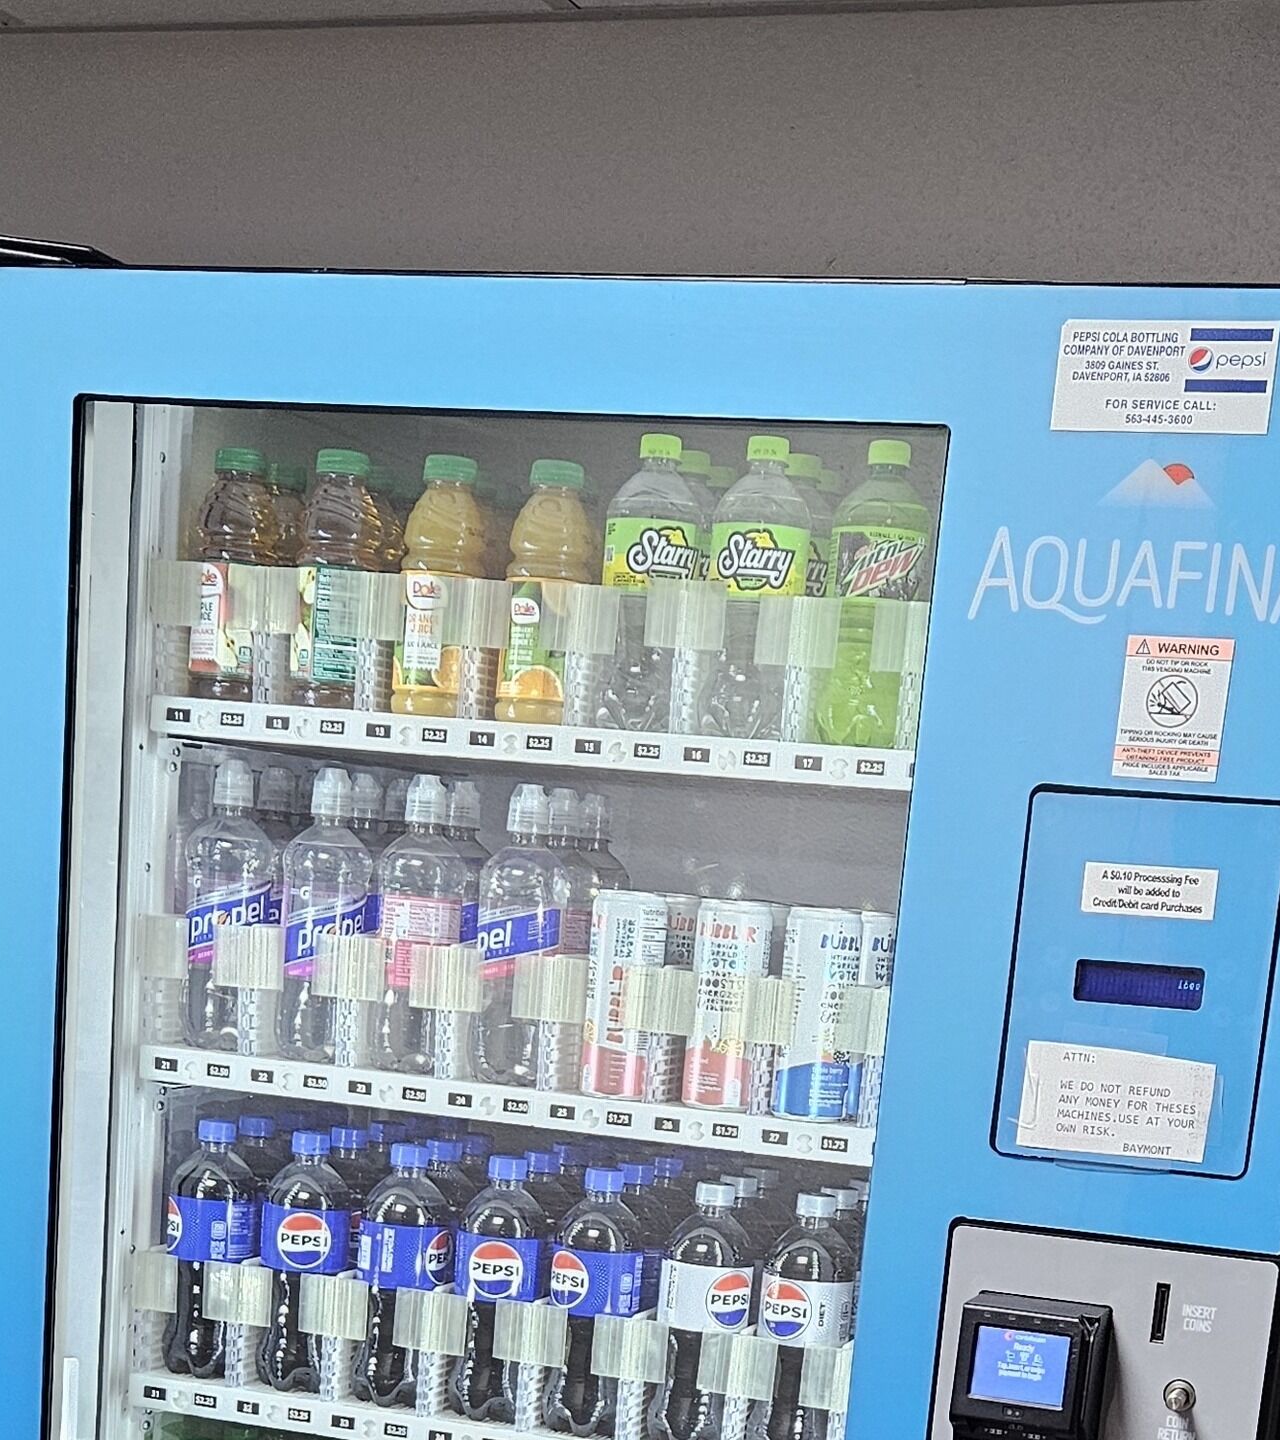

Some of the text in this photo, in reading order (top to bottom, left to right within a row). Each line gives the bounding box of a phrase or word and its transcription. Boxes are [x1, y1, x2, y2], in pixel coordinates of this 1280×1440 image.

[1073, 331, 1179, 343] PEPSI COLA BOTTLING
[1063, 345, 1186, 357] COMPANY OF DAVENPORT
[1107, 361, 1144, 371] GAINES
[1145, 362, 1160, 371] ST.
[1215, 352, 1267, 370] pepsi
[1072, 371, 1130, 383] DAVENPORT,
[1132, 373, 1143, 382] IA
[1105, 399, 1217, 411] FOR SERVICE CALL:
[1125, 414, 1193, 425] 563-445-3600
[628, 528, 698, 582] Starry
[720, 530, 796, 589] Starry
[413, 580, 442, 596] Dole
[513, 602, 537, 614] Dole
[1157, 643, 1220, 656] WARNING
[174, 710, 814, 769] 11 $2.25 17
[1102, 870, 1109, 879] A
[1110, 870, 1133, 881] $0.10
[1184, 875, 1200, 886] Fee
[1118, 885, 1181, 898] will be added to
[1140, 900, 1159, 910] card
[1160, 901, 1203, 914] Purchases
[1063, 1052, 1096, 1064] ATTN:
[160, 1060, 426, 1101] 21 $2.50
[1060, 1080, 1171, 1098] WE DO NOT REFUND
[1058, 1094, 1196, 1115] ANY MONEY FOR THESES
[1056, 1122, 1115, 1137] OWN RISK.
[1146, 1116, 1161, 1126] AT
[1167, 1117, 1196, 1130] YOUR
[1122, 1143, 1172, 1156] BAYMONT
[280, 1232, 328, 1248] PEPSI
[473, 1261, 520, 1277] PEPSI
[551, 1271, 585, 1289] PEPSI
[765, 1302, 808, 1320] PEPSI
[1182, 1303, 1217, 1321] INSERT
[1183, 1317, 1213, 1333] COINS
[1166, 1414, 1190, 1430] COIN
